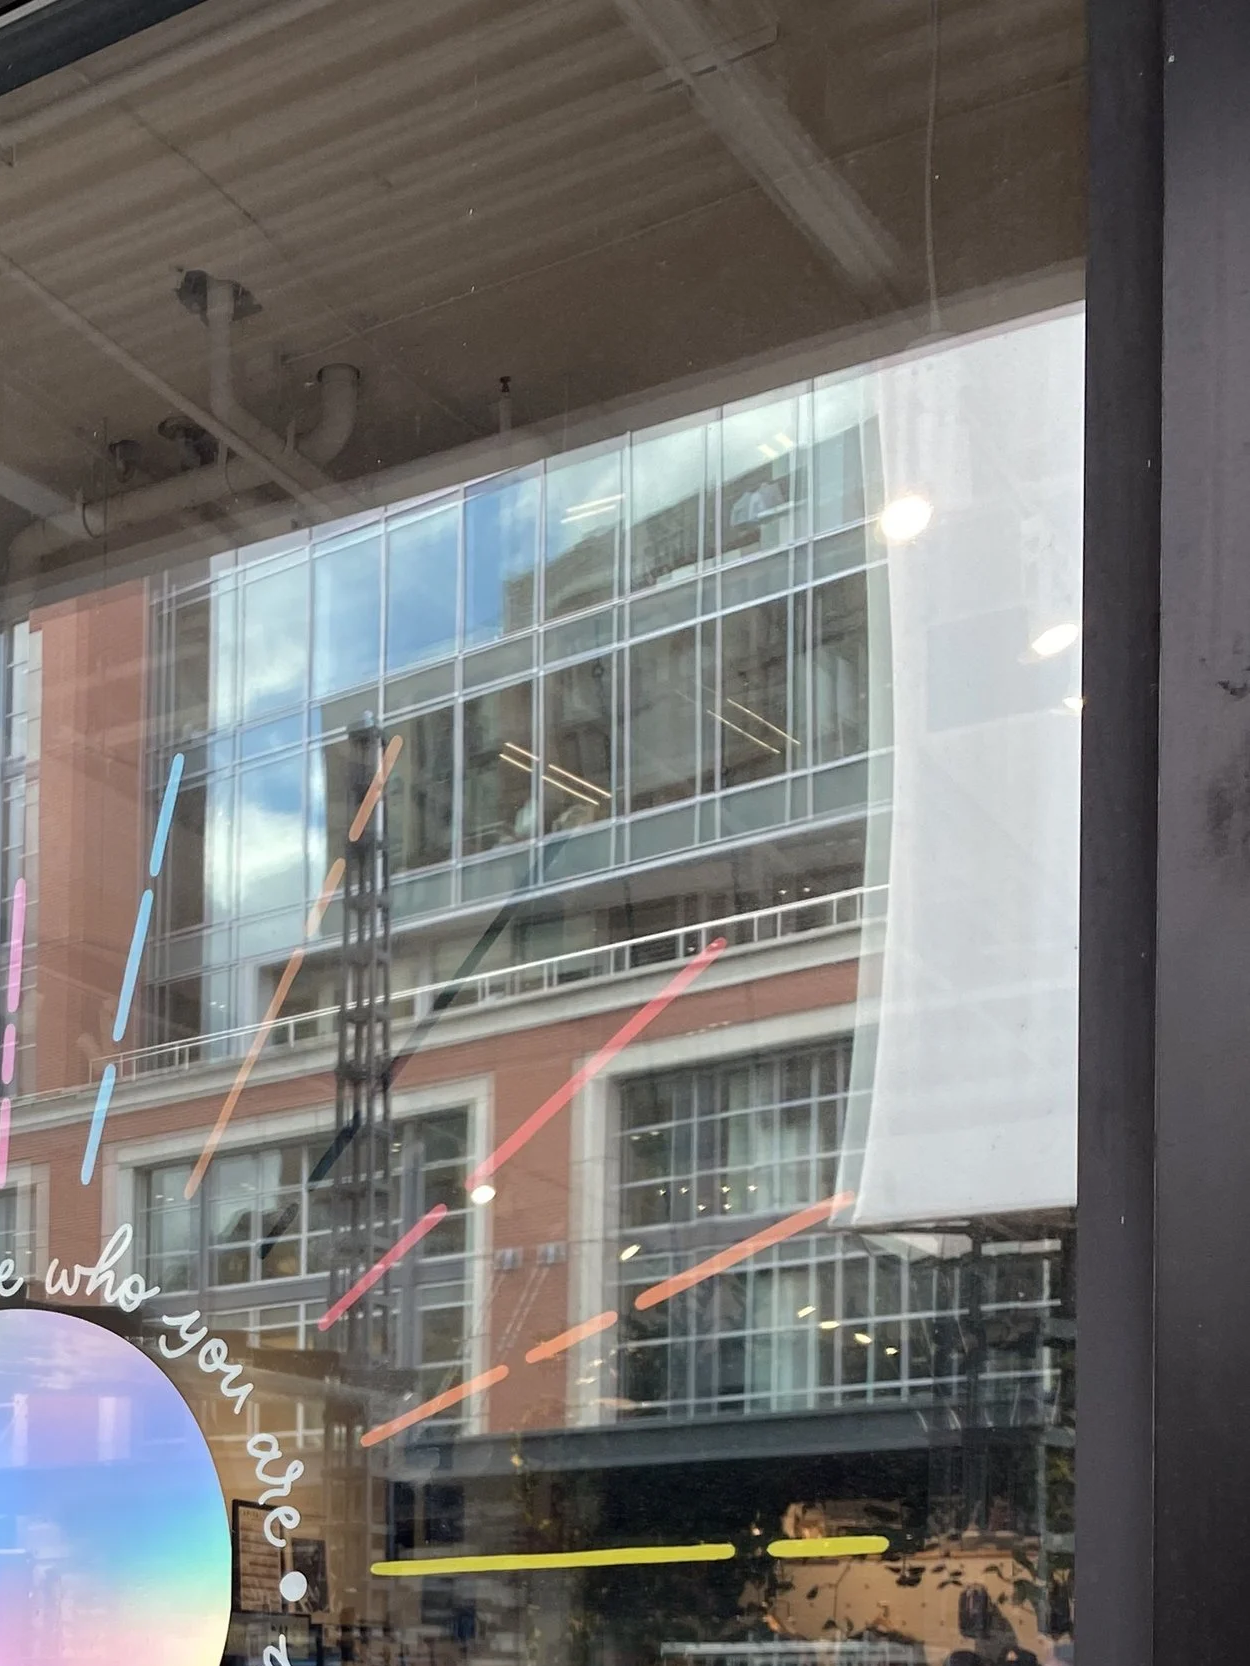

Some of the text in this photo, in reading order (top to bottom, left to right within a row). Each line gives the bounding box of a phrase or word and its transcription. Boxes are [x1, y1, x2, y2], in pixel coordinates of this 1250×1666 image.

[46, 1223, 161, 1312] who
[159, 1310, 254, 1415] you
[246, 1433, 304, 1548] are
